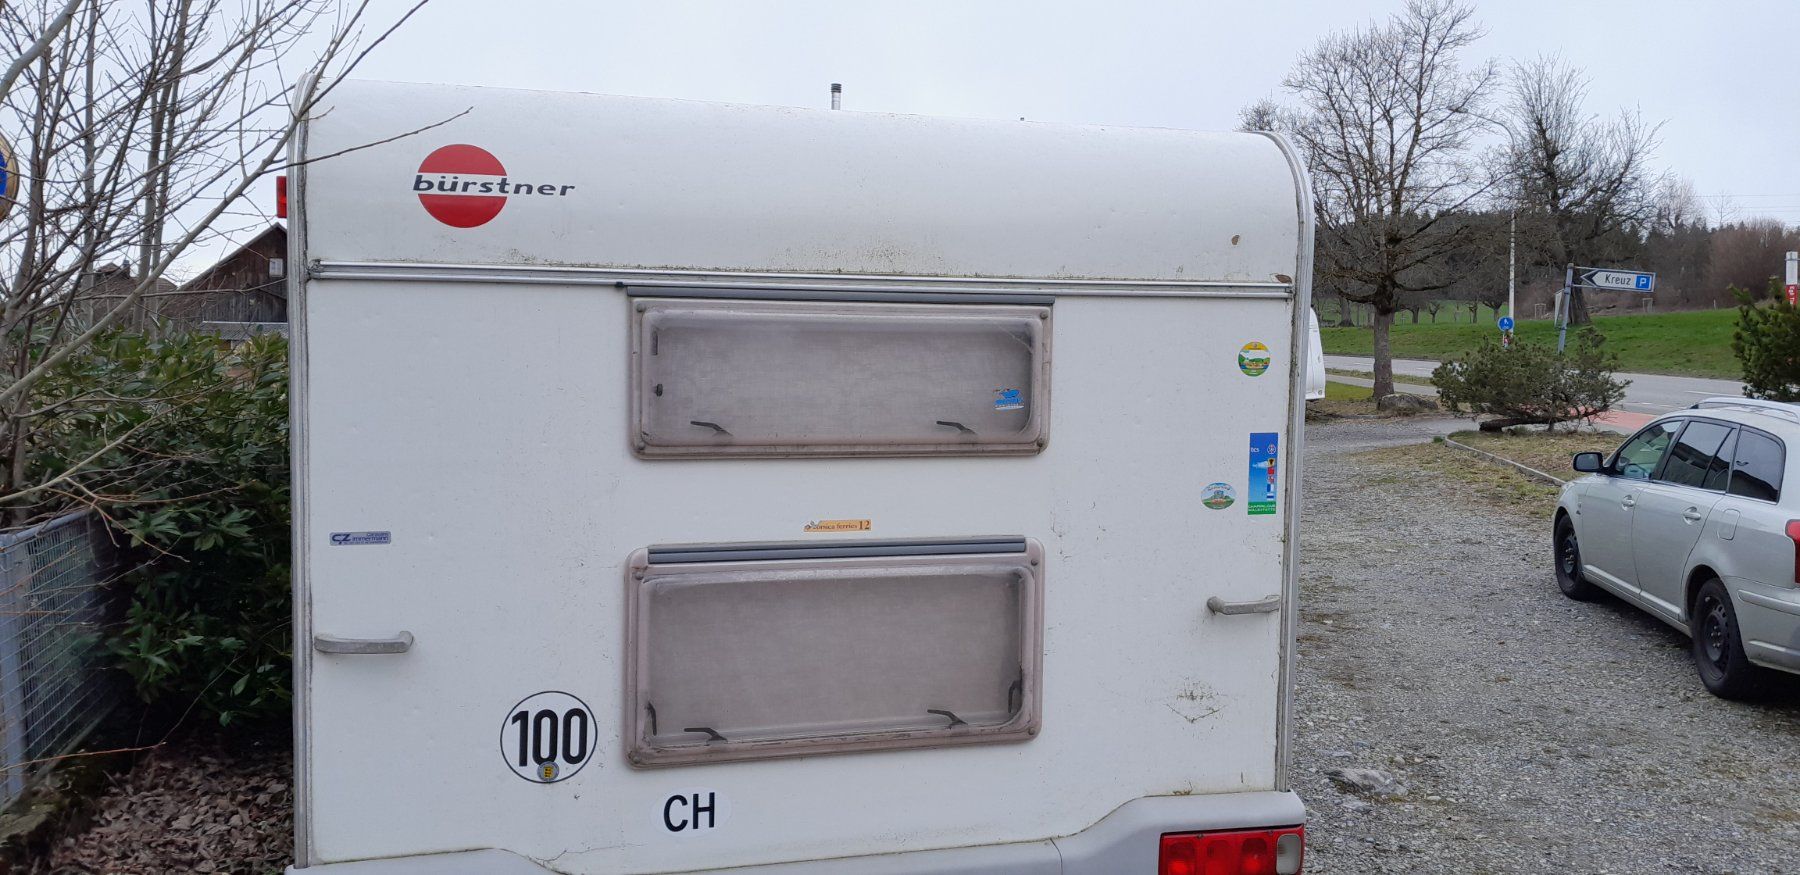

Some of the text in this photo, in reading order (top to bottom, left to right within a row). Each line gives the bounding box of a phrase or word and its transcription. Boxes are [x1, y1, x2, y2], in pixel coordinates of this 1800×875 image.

[412, 174, 576, 196] bürstner
[1605, 274, 1632, 286] Kreuz
[859, 520, 870, 530] 12
[511, 708, 588, 767] 100
[663, 792, 716, 832] CH
